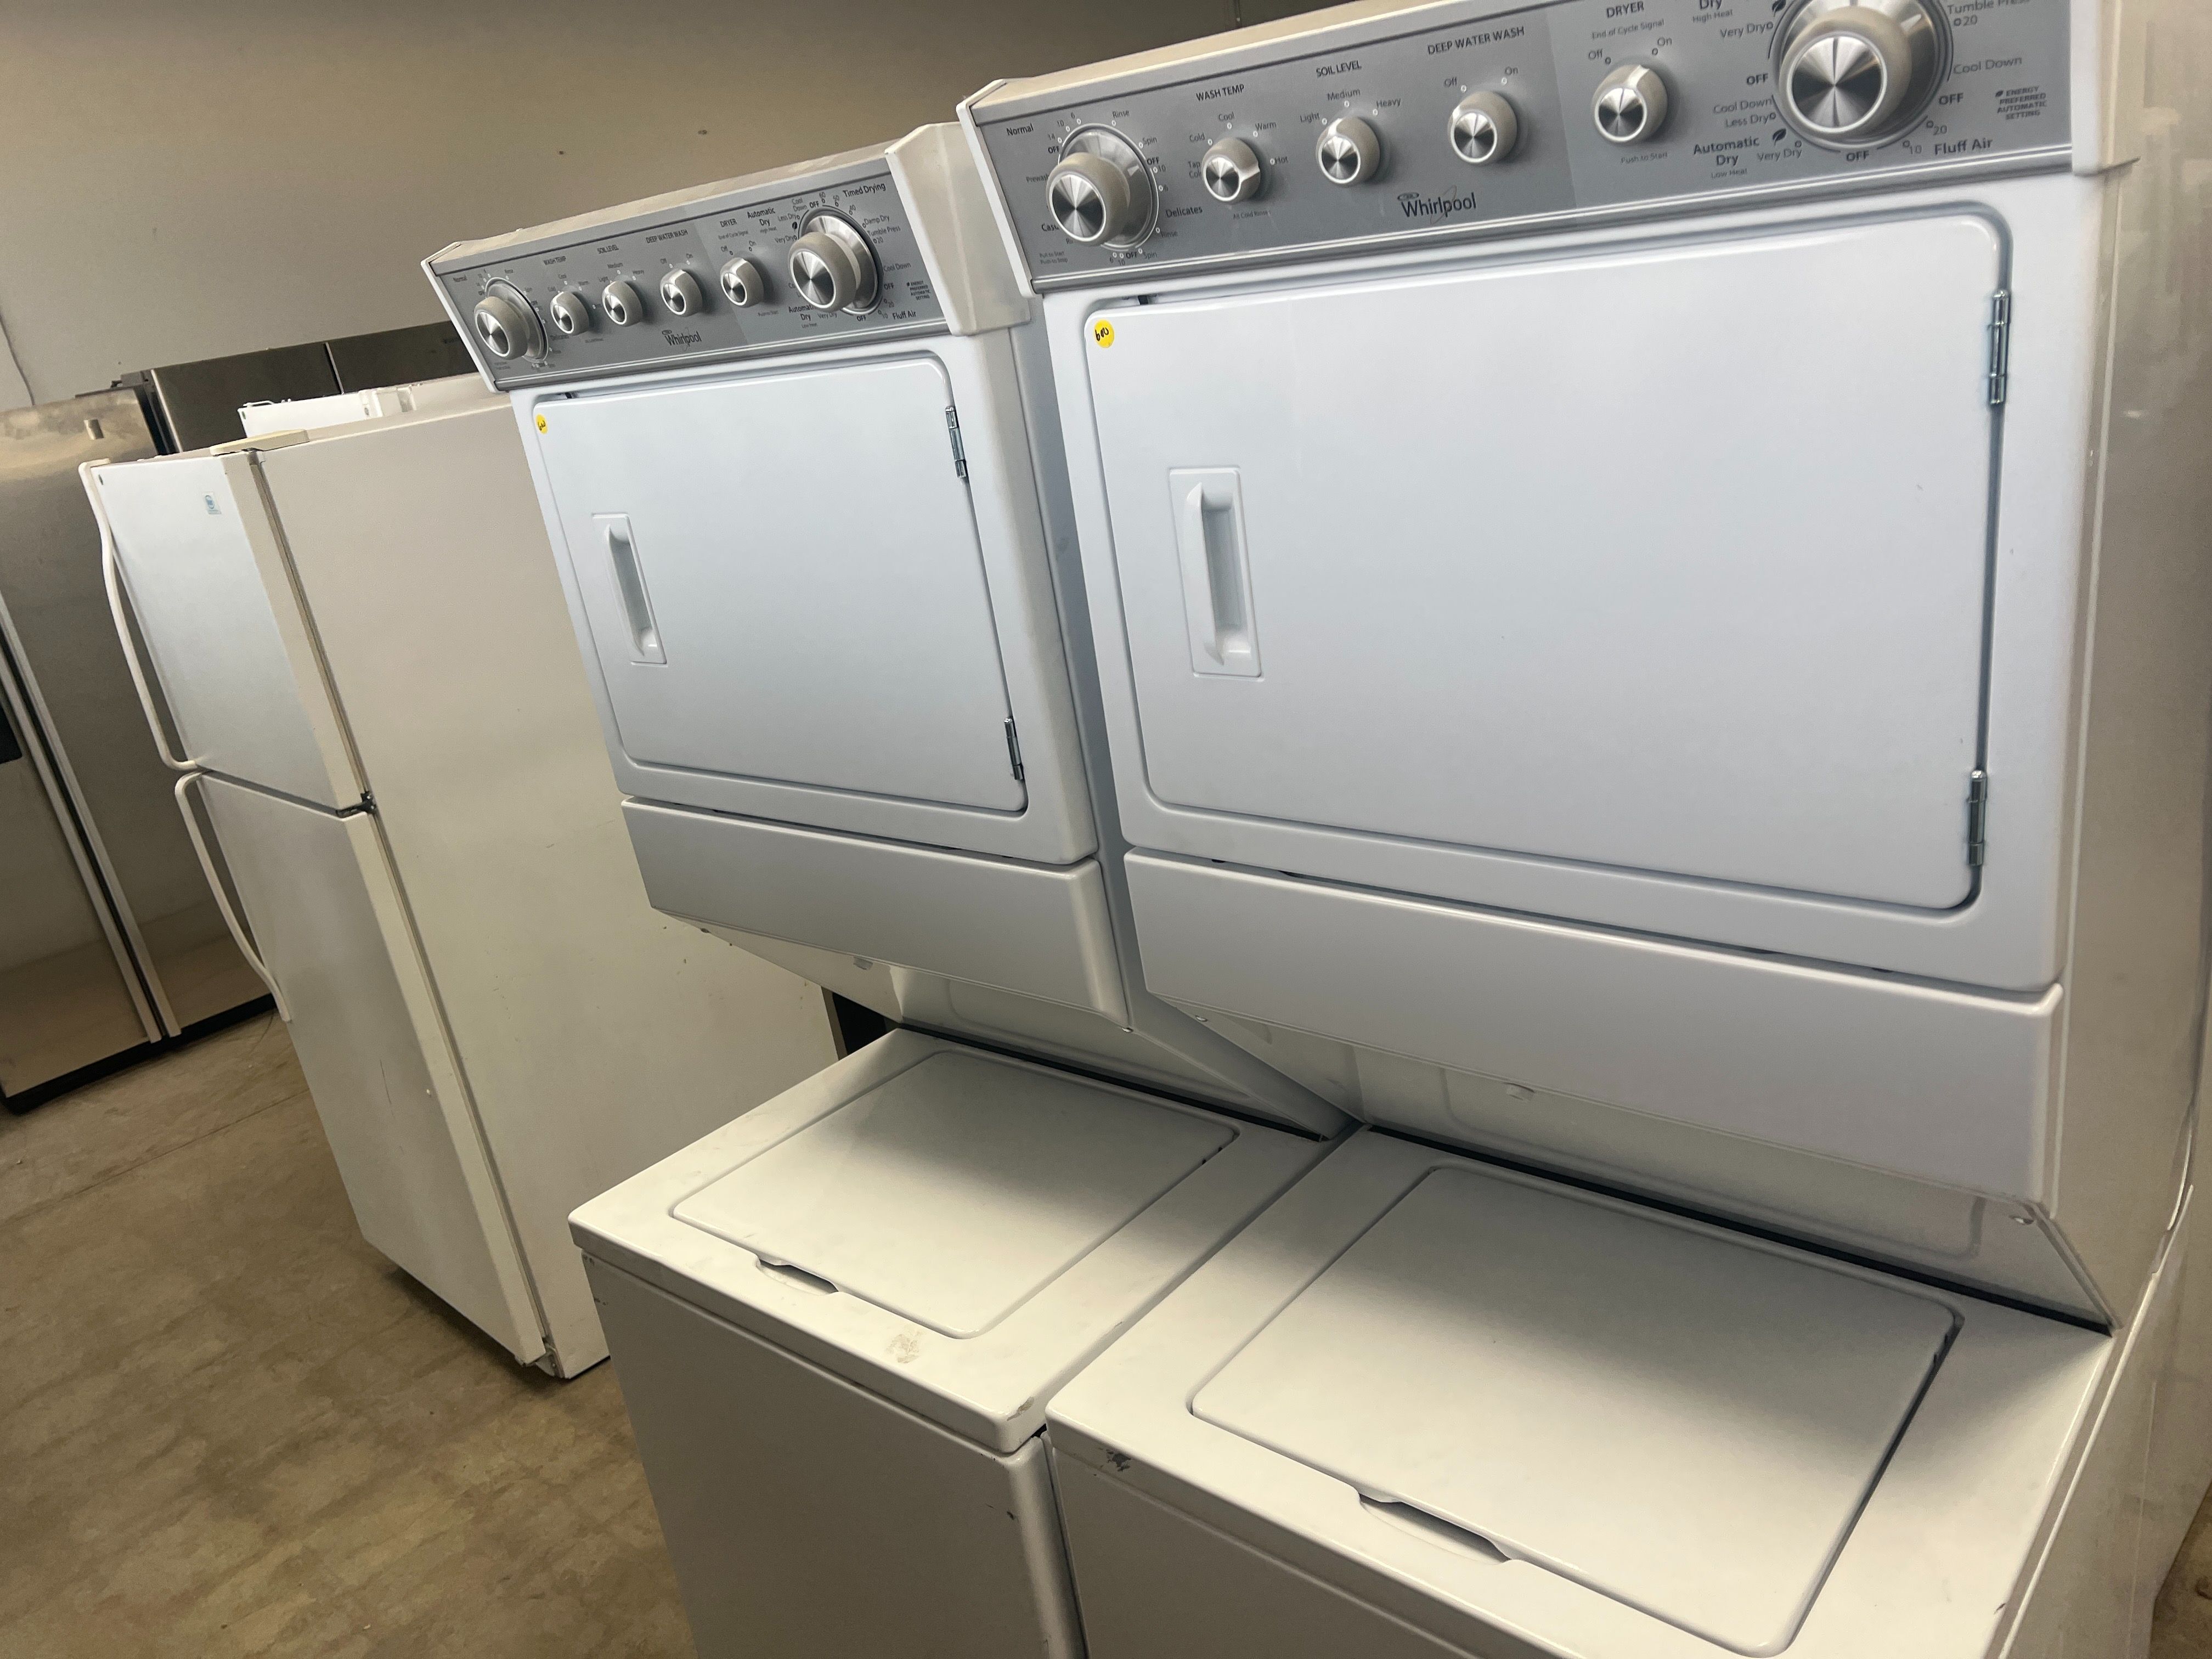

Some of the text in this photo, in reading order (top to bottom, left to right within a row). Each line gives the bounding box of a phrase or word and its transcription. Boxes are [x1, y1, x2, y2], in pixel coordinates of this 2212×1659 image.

[1607, 1, 1644, 18] DRYER
[1948, 0, 1994, 14] Tumble
[1963, 14, 1978, 26] 20
[1592, 30, 1606, 40] End
[1618, 24, 1639, 35] Cycle
[1640, 19, 1664, 31] Signal
[1720, 22, 1767, 38] Very Dry
[1428, 26, 1525, 55] DEEP WATER WASH
[1657, 37, 1672, 46] On
[1588, 49, 1602, 60] Off
[1316, 60, 1362, 77] SOIL LEVEL
[1505, 66, 1519, 75] On
[1953, 57, 2023, 74] Cool Down
[1444, 77, 1457, 87] Off
[1746, 73, 1769, 85] OFF
[1196, 84, 1245, 101] WASH TEMP
[1327, 88, 1361, 101] Medium
[1376, 98, 1401, 108] Heavy
[1939, 93, 1963, 105] OFF
[1713, 98, 1772, 114] Cool Down
[1113, 110, 1130, 119] Rinse
[1218, 112, 1234, 121] Cool
[1300, 112, 1319, 123] Light
[1726, 114, 1770, 127] Less Dry
[1007, 123, 1034, 136] Normal
[1255, 122, 1277, 131] Warm
[1933, 125, 1947, 136] 20
[1143, 137, 1157, 146] Spin
[1189, 133, 1205, 142] Cold
[1694, 136, 1759, 155] Automatic
[1910, 145, 1922, 154] 10
[1935, 138, 1993, 155] Fluff Air
[1147, 157, 1159, 165] OFF
[1717, 155, 1739, 166] Dry
[1757, 148, 1802, 162] Very Dry
[1846, 150, 1870, 162] OFF
[843, 183, 886, 197] Timed Drying
[1401, 192, 1476, 217] Whirlpool
[747, 207, 776, 218] Automatic
[1166, 206, 1203, 218] Delicates
[720, 218, 737, 228] DRYER
[788, 304, 814, 313] Automat
[893, 312, 906, 320] Fluff
[664, 330, 702, 347] Whirlpool
